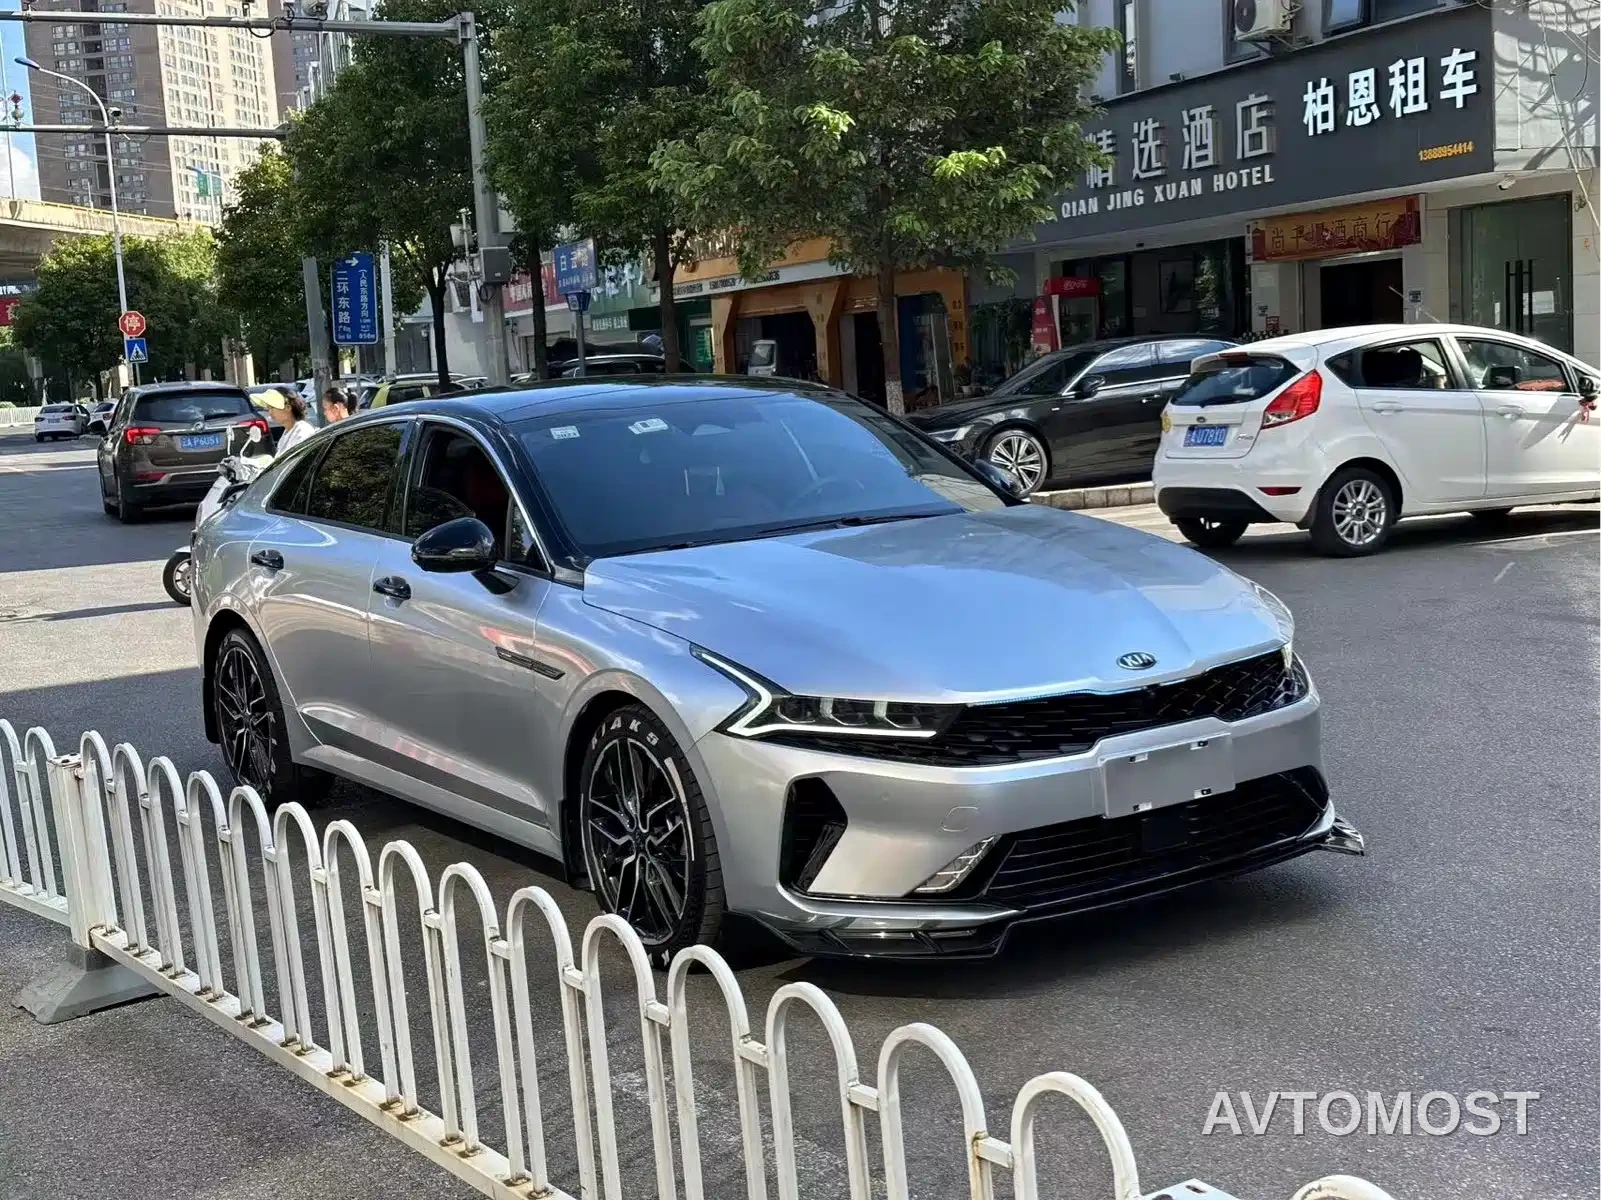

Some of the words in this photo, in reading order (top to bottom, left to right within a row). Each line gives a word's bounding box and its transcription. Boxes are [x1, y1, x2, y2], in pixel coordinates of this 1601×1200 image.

[1303, 47, 1477, 136] 柏恩租车
[1418, 141, 1474, 161] 13888954414
[1061, 197, 1099, 218] QIAN
[1106, 189, 1144, 211] JING
[1154, 178, 1202, 203] XUAN
[1213, 164, 1275, 192] HOTEL
[336, 270, 350, 324] 二环东路
[124, 315, 141, 332] 停
[1121, 652, 1155, 668] KIA
